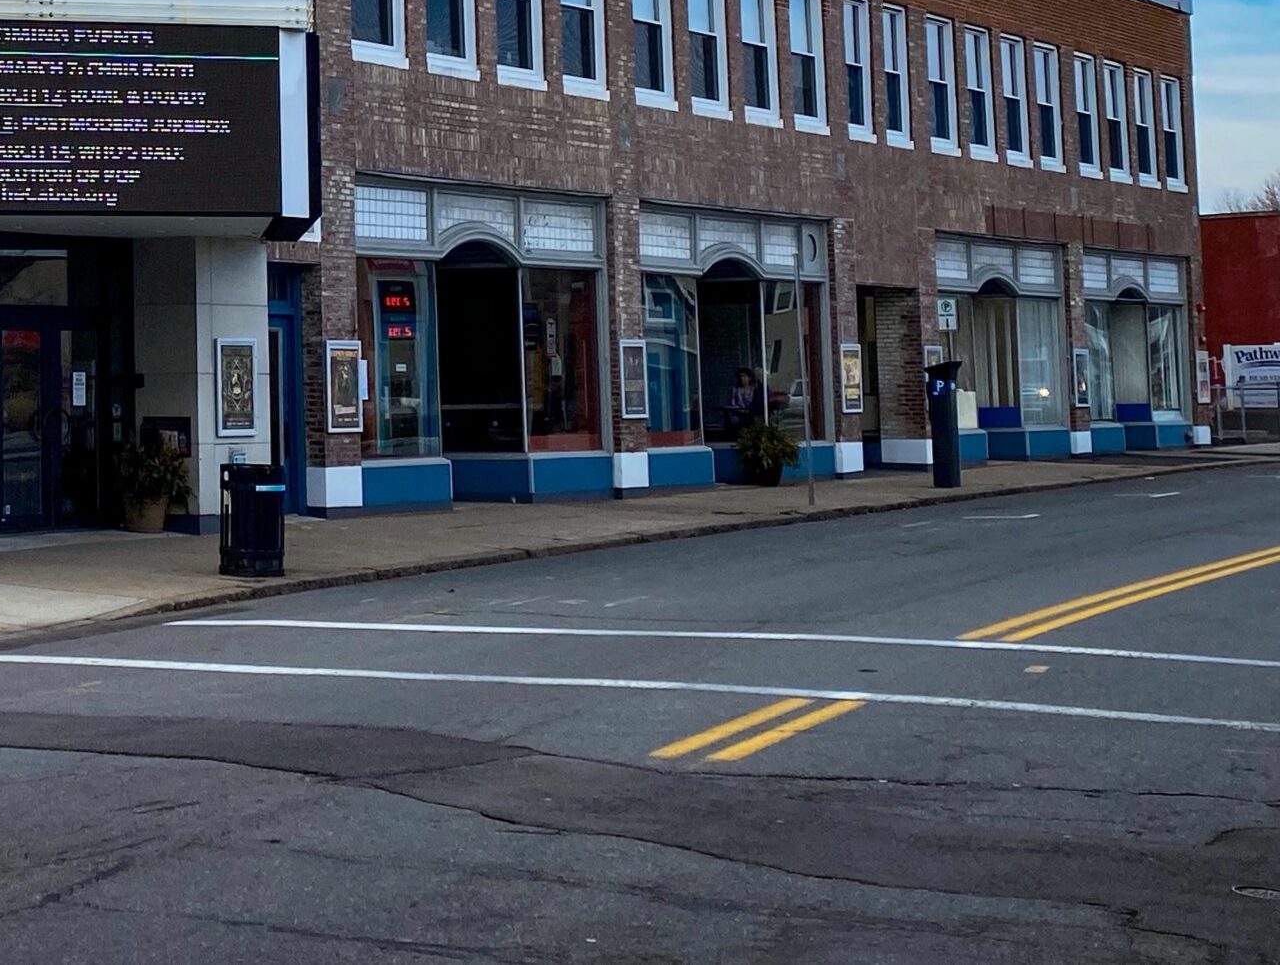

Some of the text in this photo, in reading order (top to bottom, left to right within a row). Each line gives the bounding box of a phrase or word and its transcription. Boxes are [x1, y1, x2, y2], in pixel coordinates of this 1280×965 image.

[73, 29, 155, 48] EVENTS
[87, 61, 140, 78] CHRIS
[21, 116, 149, 133] POSTMODERN
[75, 168, 101, 184] OF
